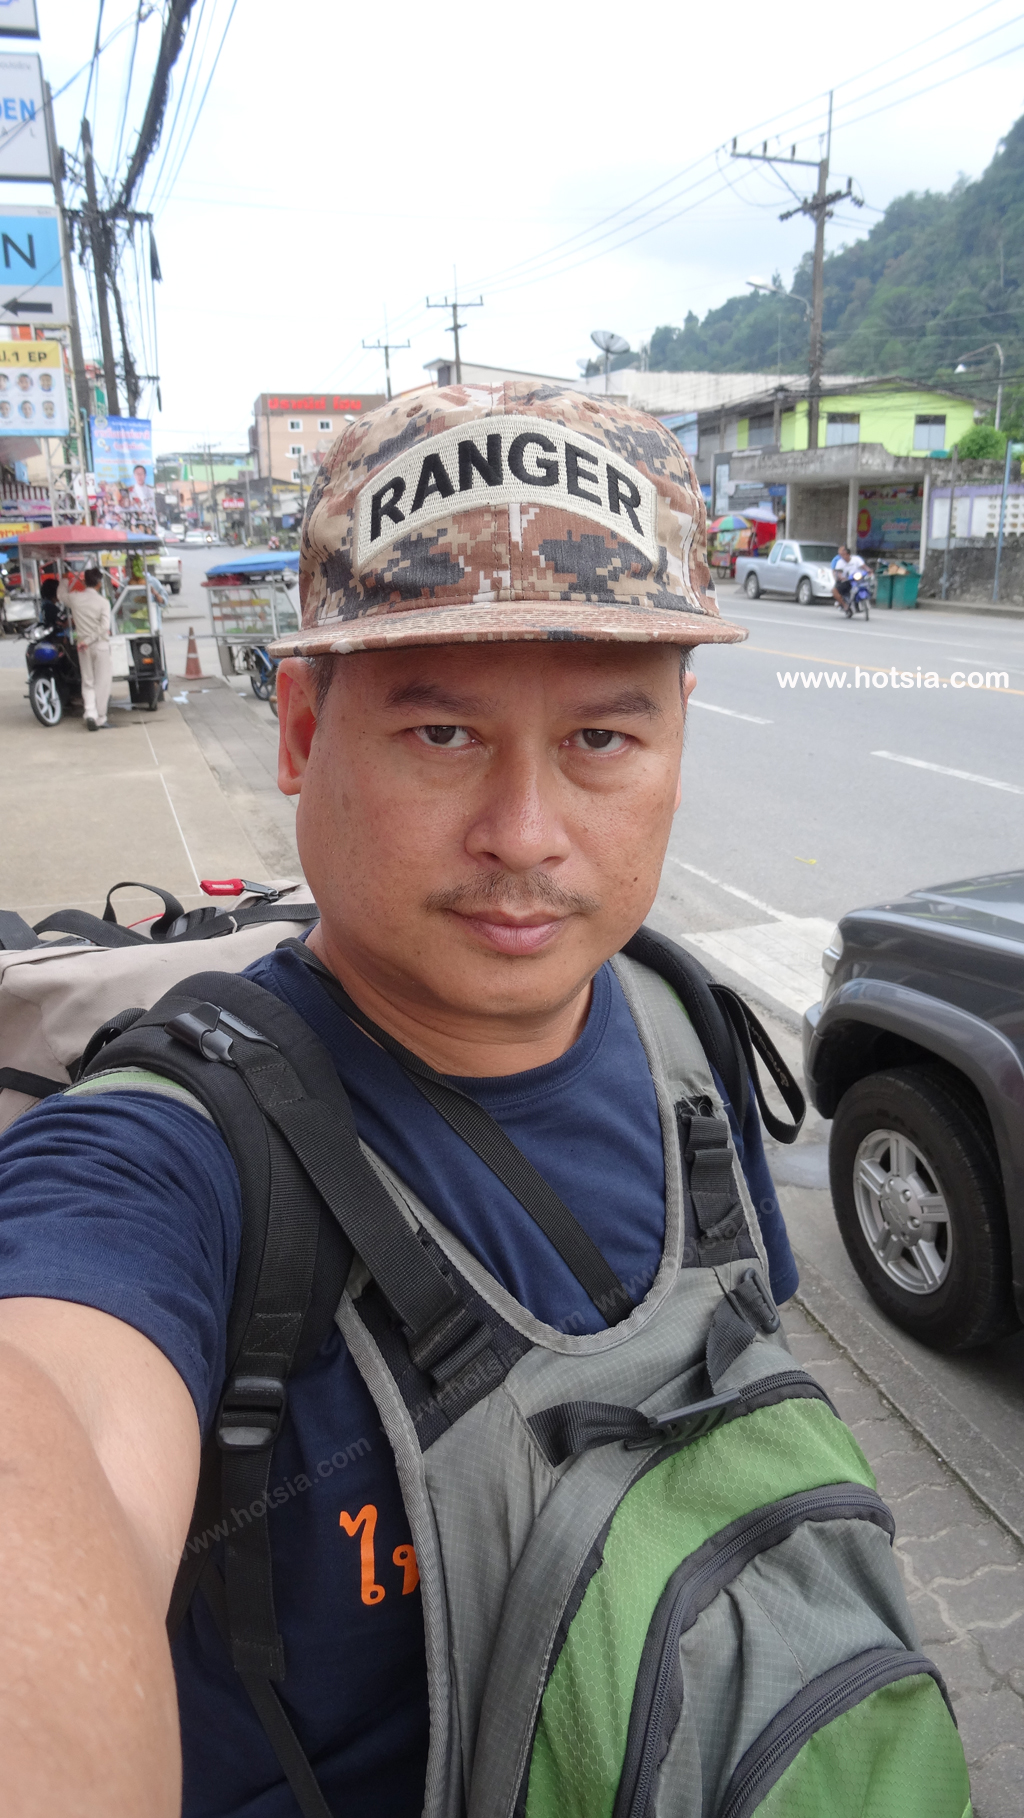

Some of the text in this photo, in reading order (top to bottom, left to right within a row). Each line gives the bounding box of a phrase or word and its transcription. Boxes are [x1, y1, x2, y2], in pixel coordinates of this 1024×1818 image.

[0, 97, 35, 121] EN
[28, 351, 47, 362] EP
[370, 432, 645, 542] RANGER
